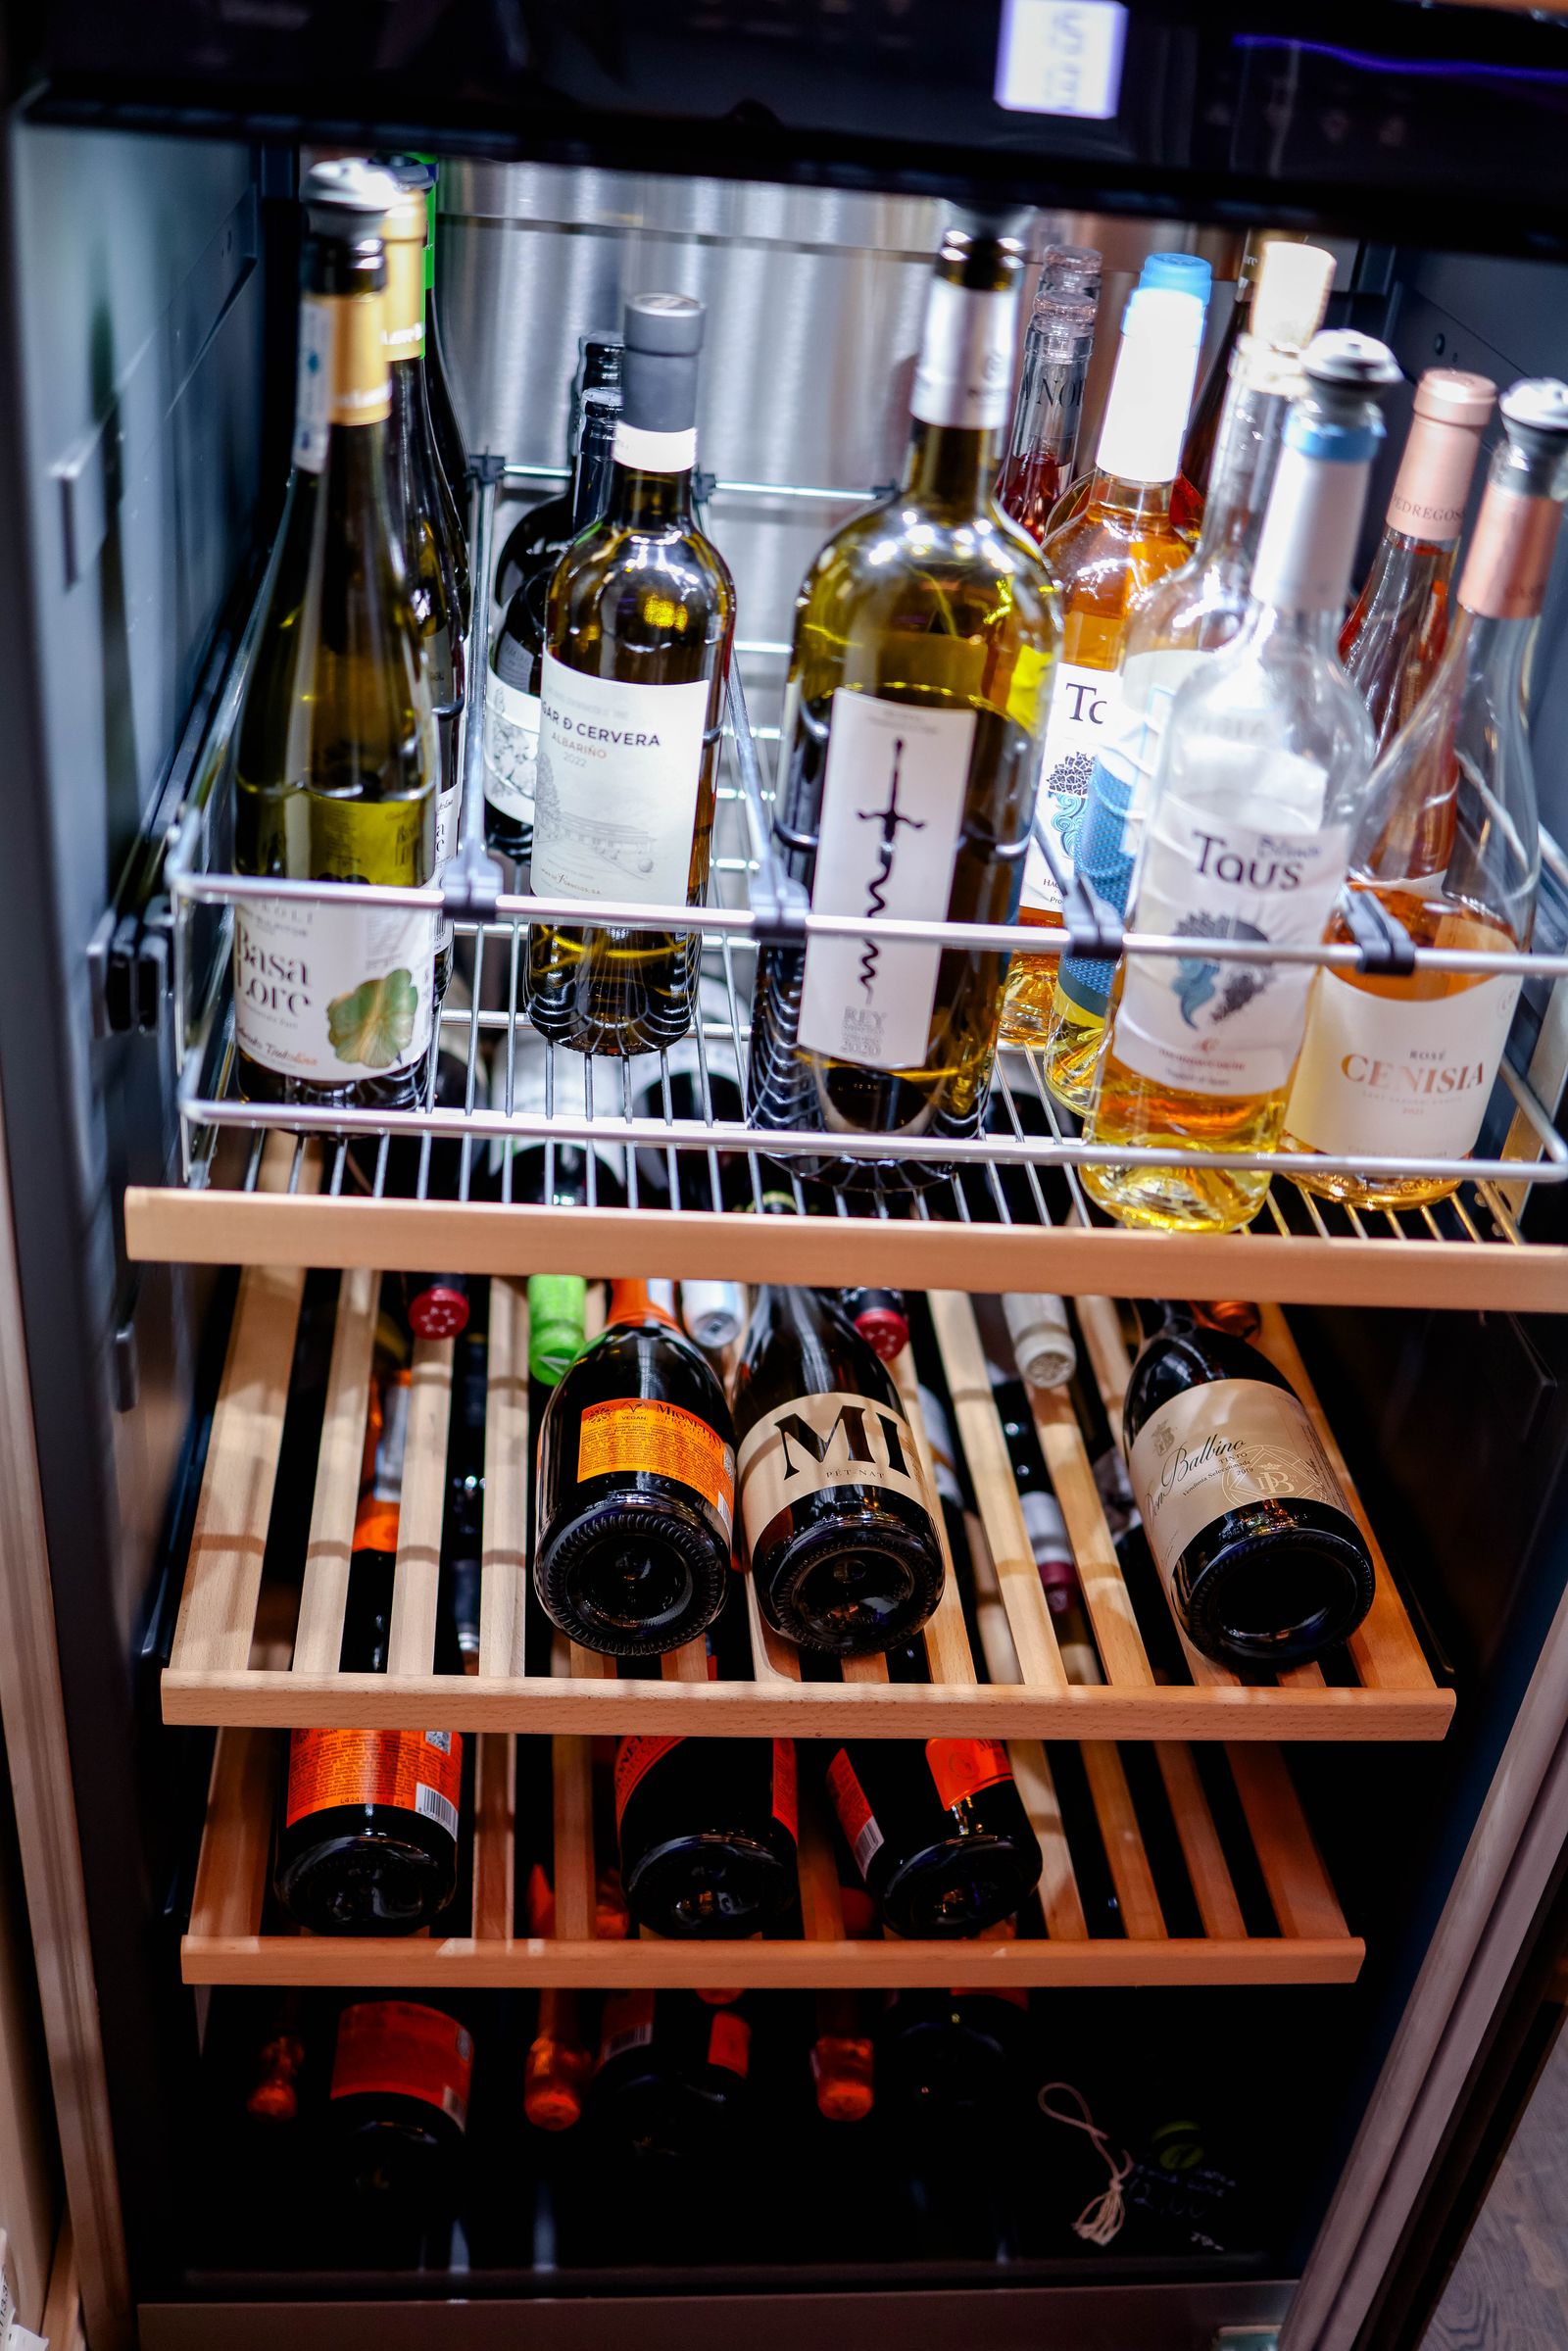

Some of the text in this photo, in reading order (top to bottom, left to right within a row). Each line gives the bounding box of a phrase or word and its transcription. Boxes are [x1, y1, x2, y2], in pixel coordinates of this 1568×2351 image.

[552, 732, 608, 759] ALBARIÑO
[576, 722, 661, 747] CERVERA
[1192, 831, 1302, 891] Taus
[237, 921, 308, 985] Basa
[1341, 1053, 1484, 1095] CENISIA
[1161, 1433, 1247, 1489] Balbino
[1218, 1451, 1248, 1465] TINTO
[1183, 1460, 1250, 1496] Vendimia Seleccionada
